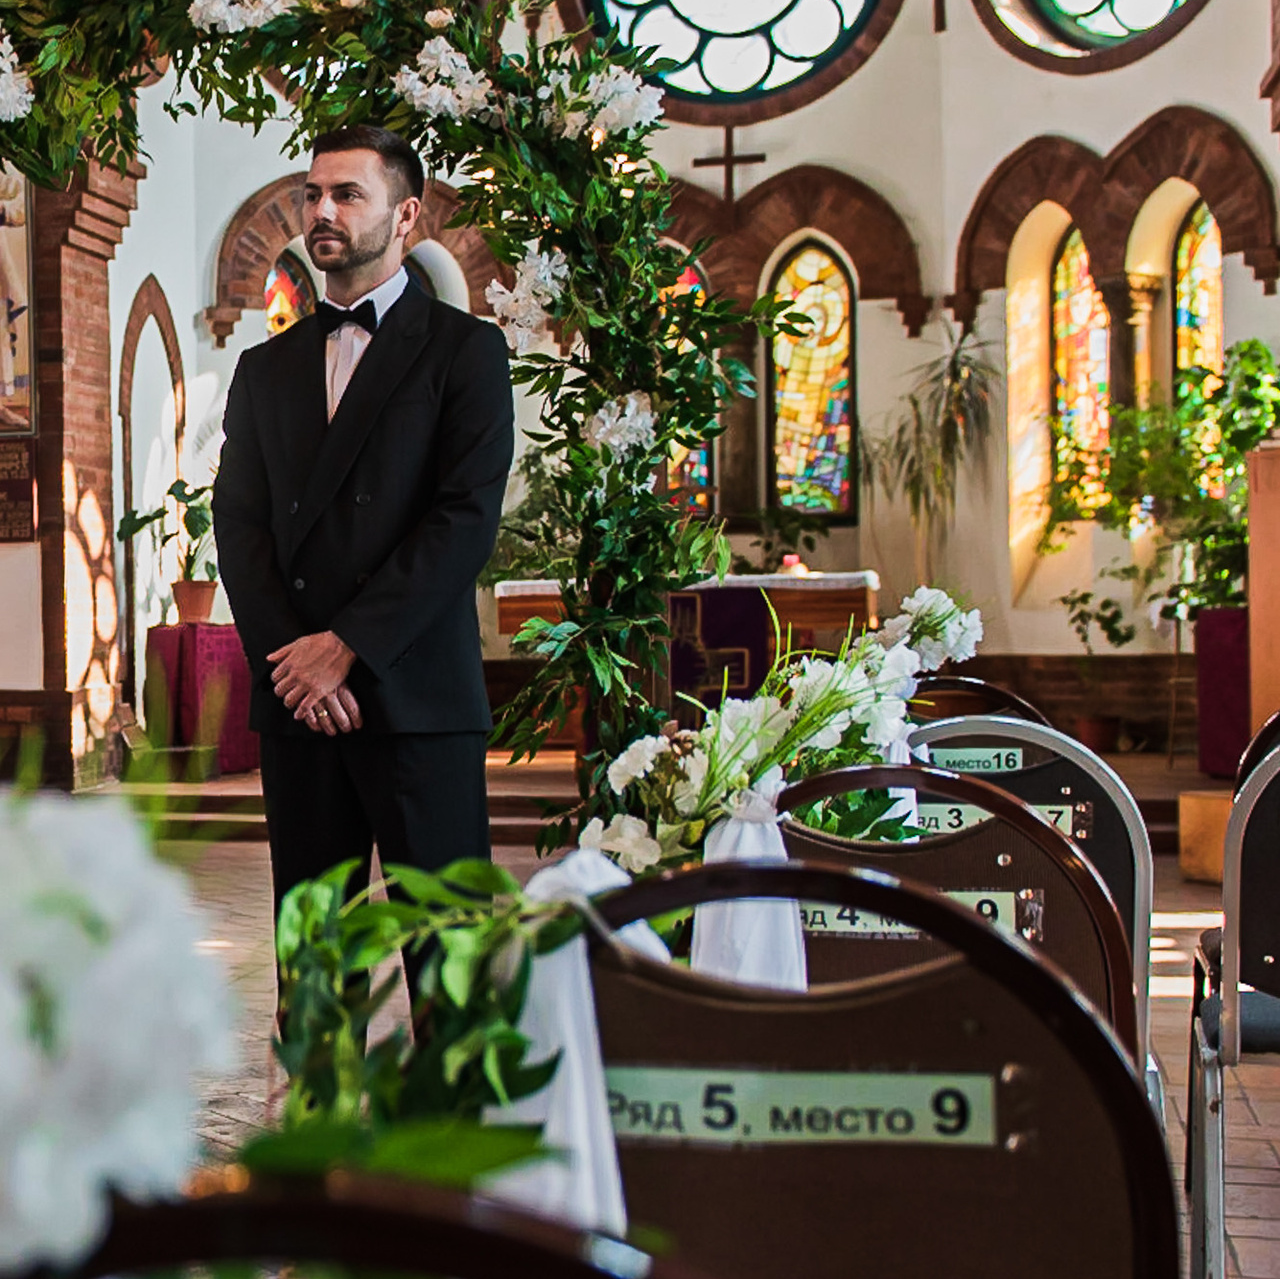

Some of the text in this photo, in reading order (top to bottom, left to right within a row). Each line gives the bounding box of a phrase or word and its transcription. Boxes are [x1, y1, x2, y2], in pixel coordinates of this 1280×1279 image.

[945, 752, 1017, 769] место 16
[947, 808, 964, 828] 3
[1048, 810, 1063, 826] 7
[976, 899, 999, 923] 9
[768, 1106, 915, 1134] место
[930, 1087, 972, 1136] 9
